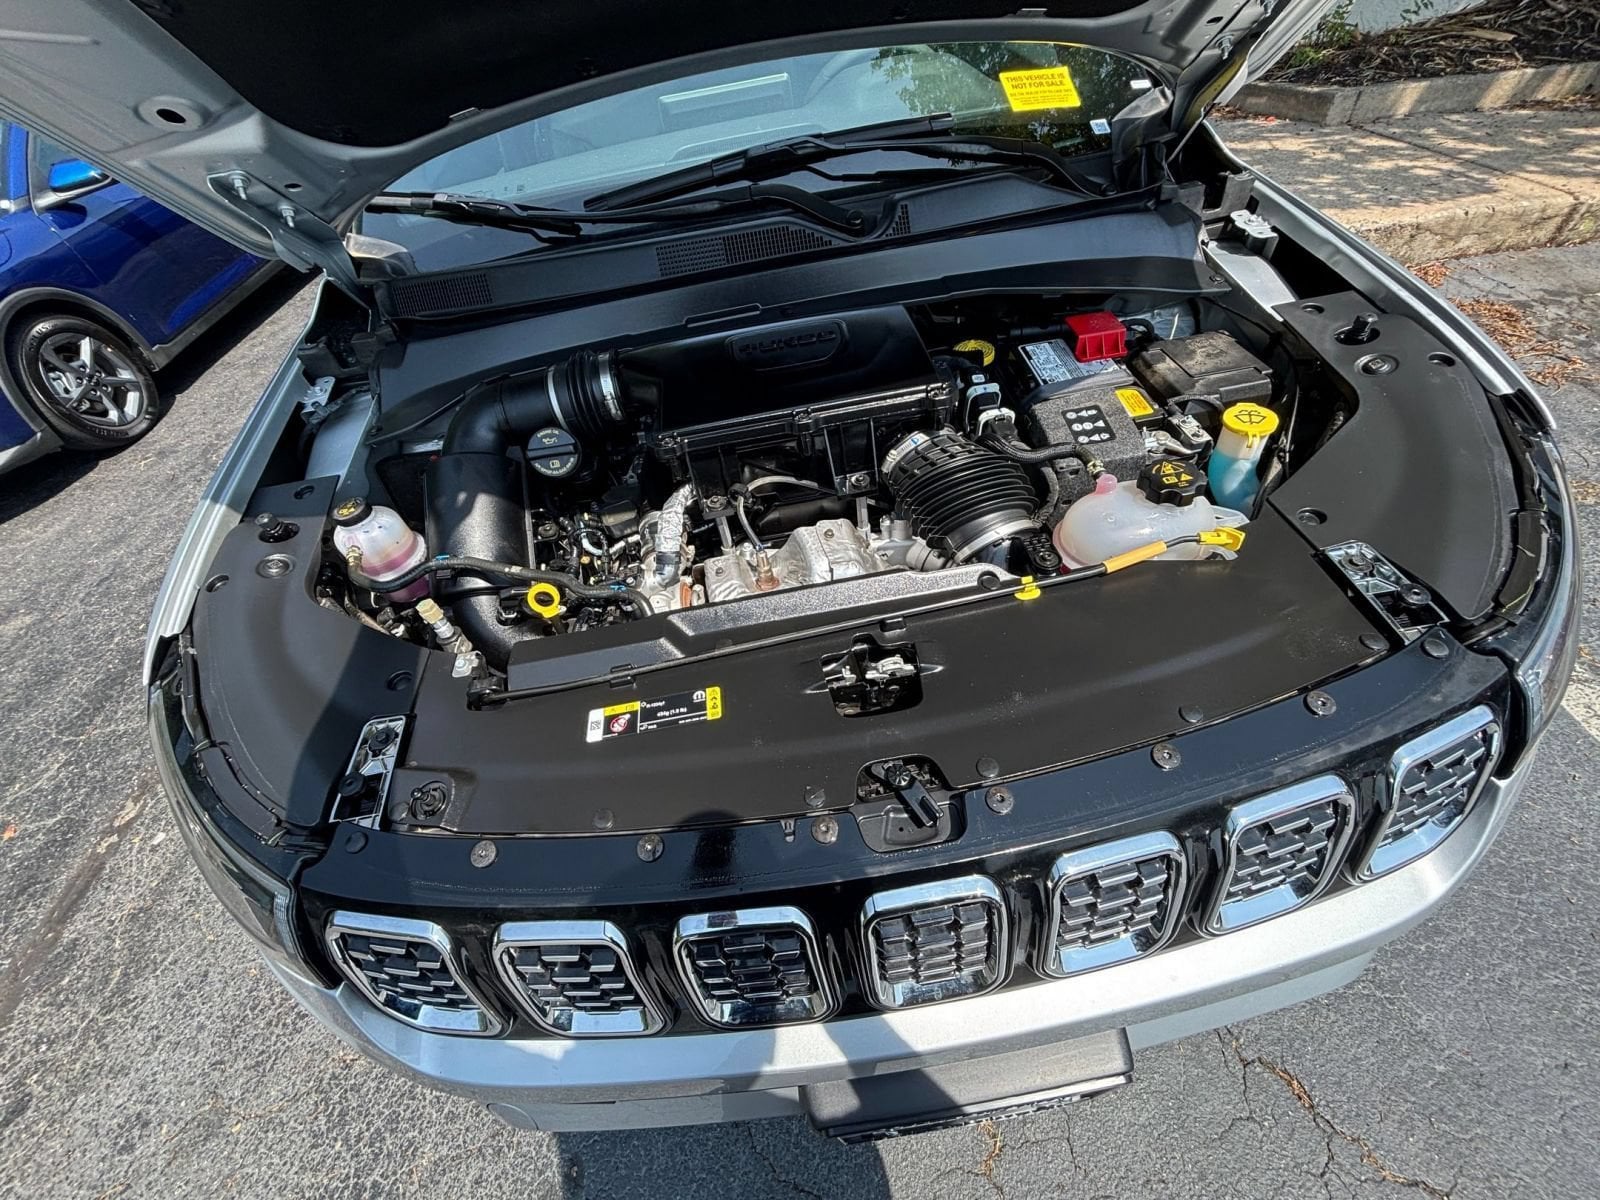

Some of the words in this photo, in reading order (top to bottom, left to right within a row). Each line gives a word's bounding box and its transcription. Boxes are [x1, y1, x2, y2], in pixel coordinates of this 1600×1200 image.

[1024, 73, 1056, 81] VEHICLE
[1011, 82, 1026, 90] NOT
[1045, 79, 1065, 87] SALE
